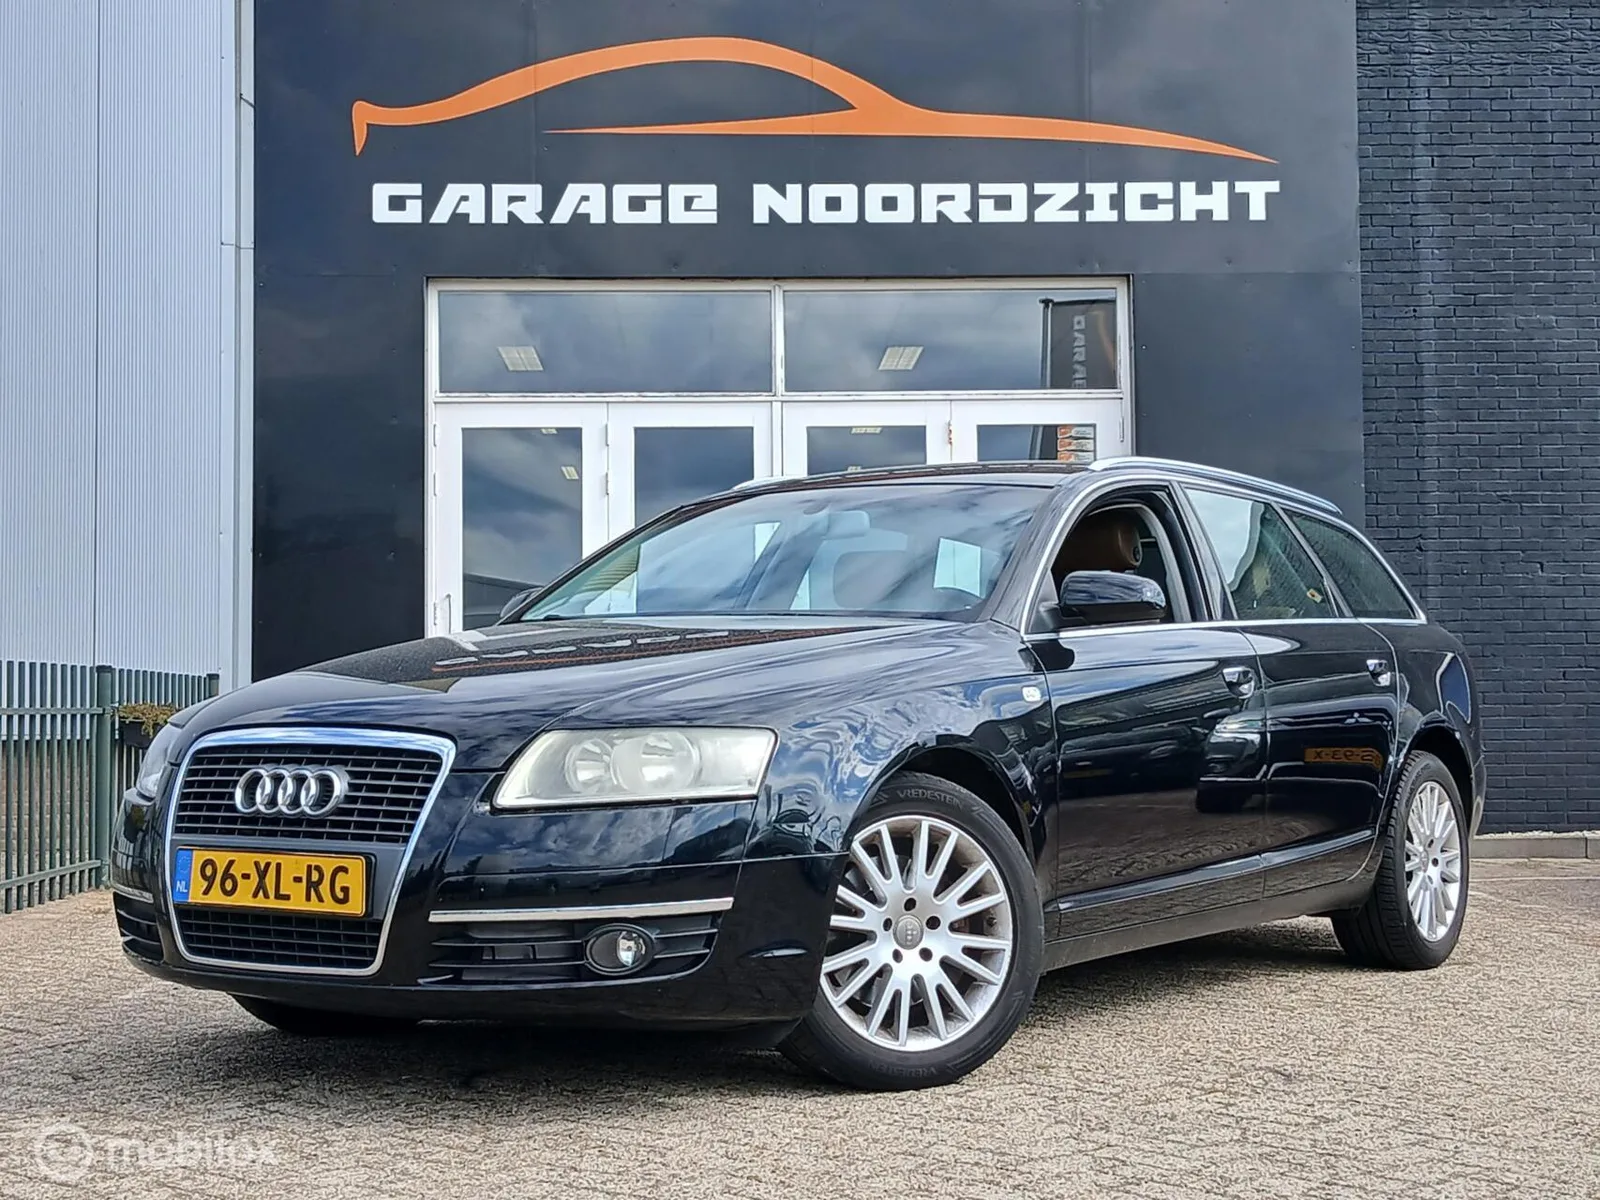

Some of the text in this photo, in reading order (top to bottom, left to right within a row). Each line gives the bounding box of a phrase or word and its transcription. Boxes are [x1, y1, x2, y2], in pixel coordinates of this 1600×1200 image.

[372, 180, 1280, 224] GARAGE NOORDZICHT
[176, 881, 188, 893] NL
[199, 858, 350, 905] 96-XL-RG
